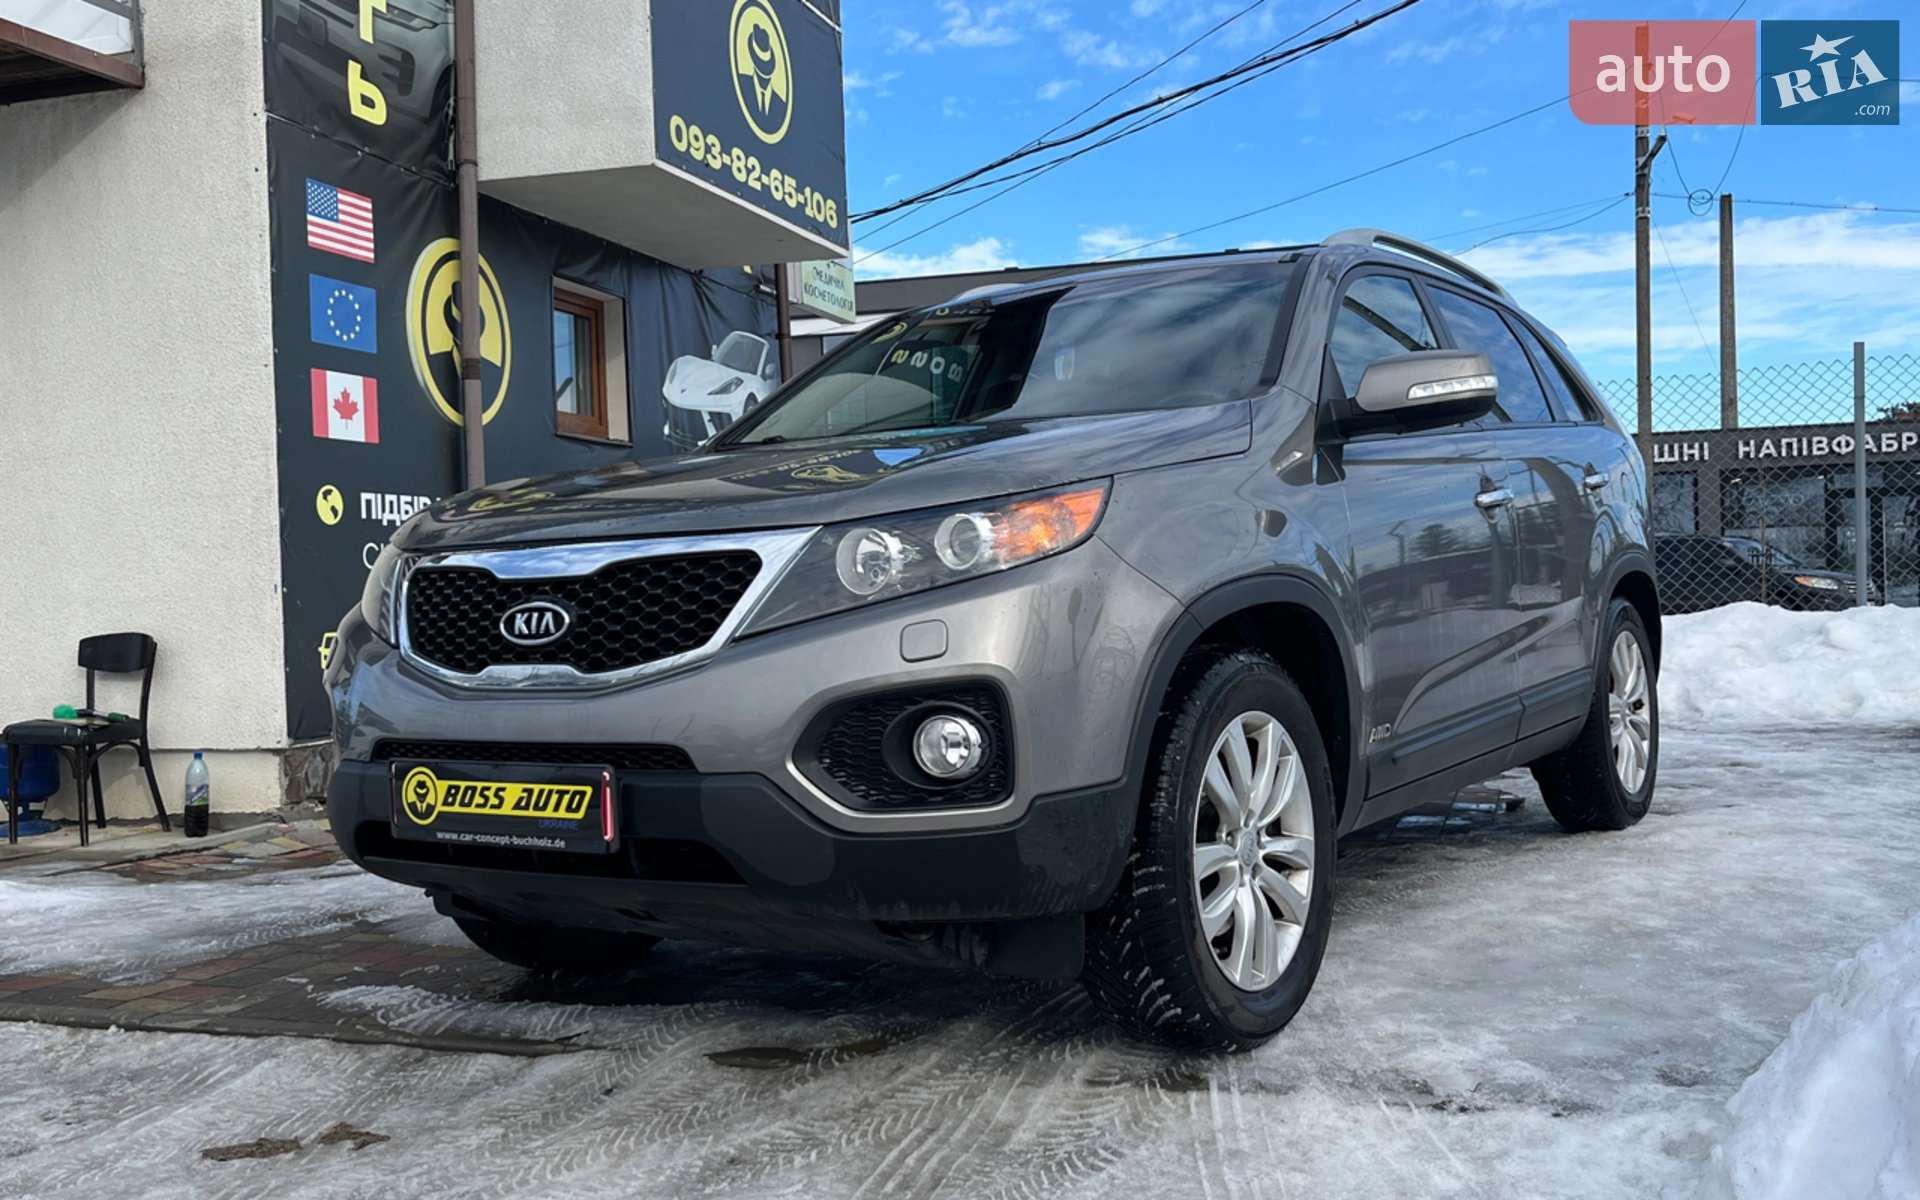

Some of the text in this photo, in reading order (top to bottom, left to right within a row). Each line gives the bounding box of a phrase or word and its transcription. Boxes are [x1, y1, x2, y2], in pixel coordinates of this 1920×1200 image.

[669, 114, 838, 229] 093-82-65-106
[514, 611, 556, 635] KIA
[441, 783, 588, 814] BOSS AUTO
[538, 818, 579, 830] UKRAINE
[436, 830, 566, 849] www.car-concept-buchholz.de
